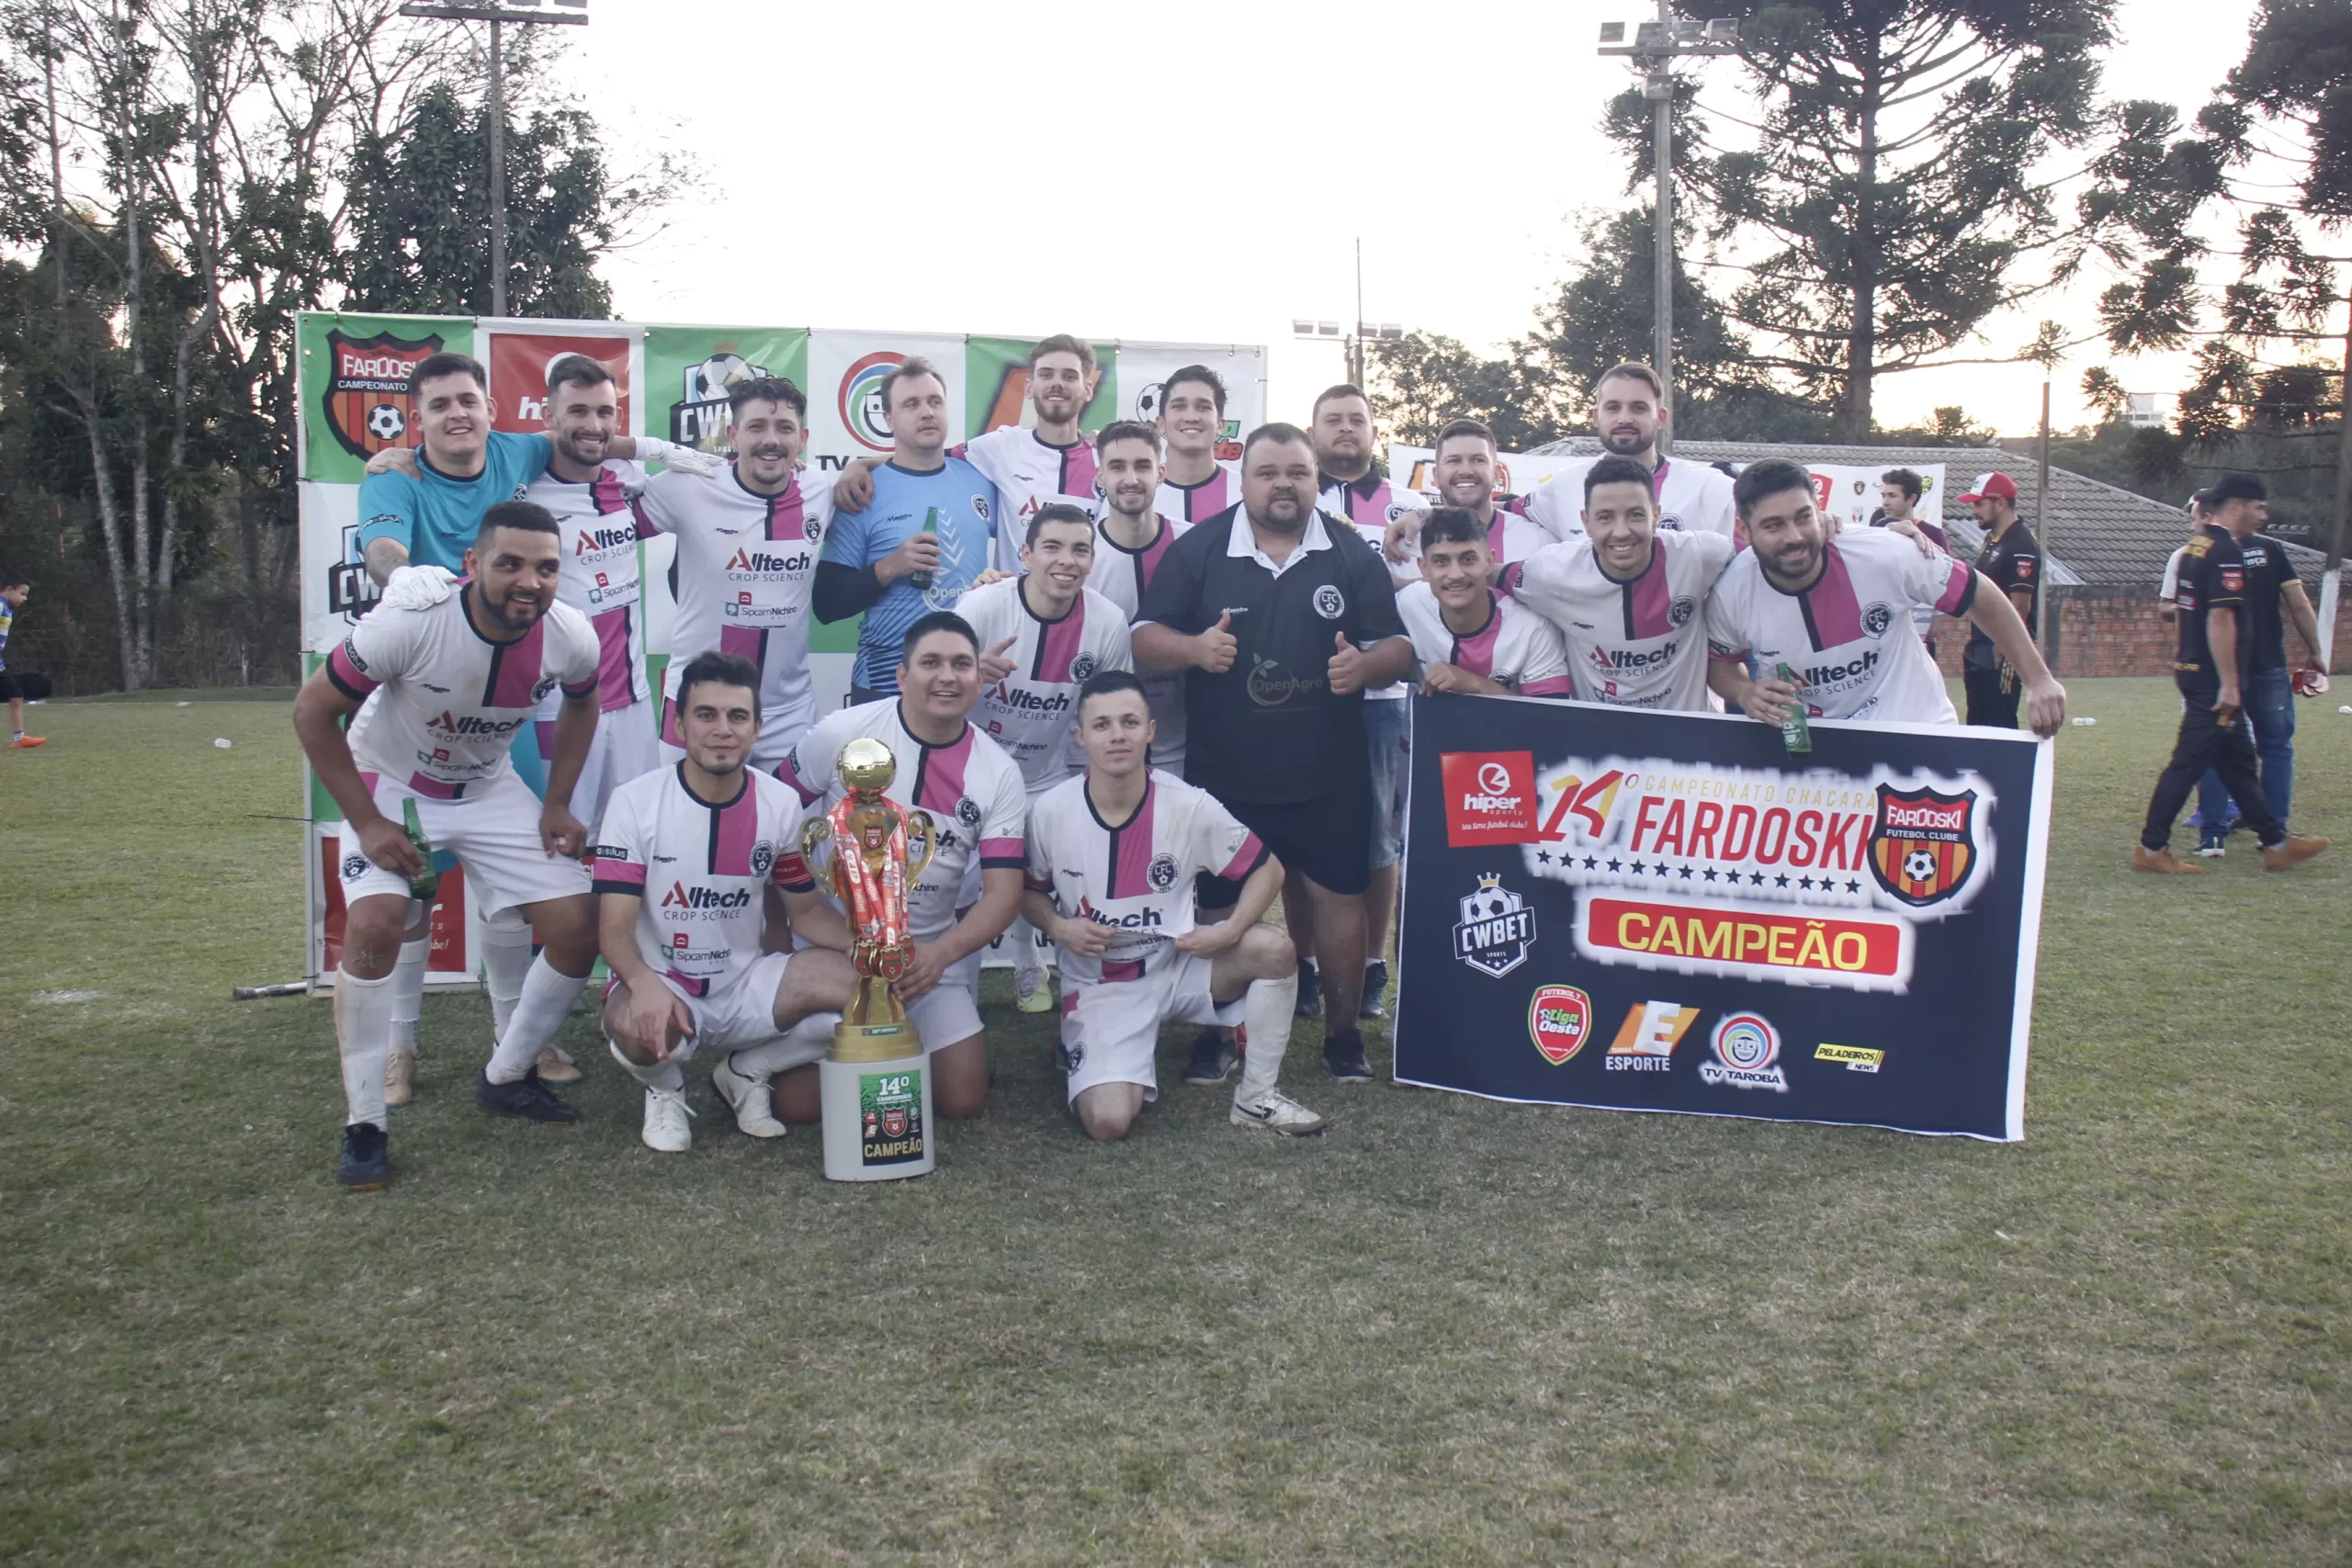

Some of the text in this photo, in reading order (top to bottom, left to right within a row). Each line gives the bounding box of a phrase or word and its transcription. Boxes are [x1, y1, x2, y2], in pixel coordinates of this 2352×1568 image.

[343, 354, 416, 378] FARDOS
[338, 379, 408, 391] CAMPEONATO
[815, 455, 849, 471] TV
[581, 551, 608, 566] CROP
[725, 547, 810, 572] Alltech
[729, 571, 805, 582] CROP SCIENCE
[928, 586, 965, 601] Open
[1321, 592, 1338, 603] CFC
[1674, 604, 1690, 616] CFC
[1868, 609, 1886, 624] CFC
[1590, 641, 1677, 669] Alltech
[1076, 660, 1091, 671] CFC
[1625, 660, 1671, 677] SCIENCE
[1253, 677, 1323, 694] OpenAgro
[1798, 669, 1876, 698] ROP SCIENCE
[984, 681, 1070, 712] Alltech
[984, 701, 1062, 722] CROP SCIENCE
[425, 710, 527, 734] Alltech
[427, 728, 462, 743] CROP
[993, 735, 1048, 750] pcamNichino
[1645, 774, 1775, 803] CAMPEONATO
[1786, 785, 1876, 809] CHÁCARA
[1464, 793, 1521, 813] hiper
[1886, 803, 1962, 829] FARDOSKI
[1487, 819, 1509, 831] futebol
[1629, 795, 1874, 872] FARDOSKI
[1886, 829, 1959, 841] FUTEBOL CLUBE
[1154, 863, 1171, 876] CFC
[661, 880, 752, 908] Alltech
[663, 908, 741, 921] CROP SCENCE
[1462, 912, 1528, 953] CWBET
[1618, 912, 1868, 971] CAMPEÃO
[1542, 988, 1582, 1000] FUTEBOL 7
[1549, 1009, 1580, 1024] Liga
[1539, 1020, 1581, 1035] Oeste
[1818, 1047, 1875, 1061] PELADEIROS
[1605, 1055, 1671, 1072] ESPORTE
[1854, 1063, 1874, 1072] NEWS
[1704, 1067, 1781, 1084] TV TAROBÁ
[864, 1137, 922, 1158] CAMPEÃO
